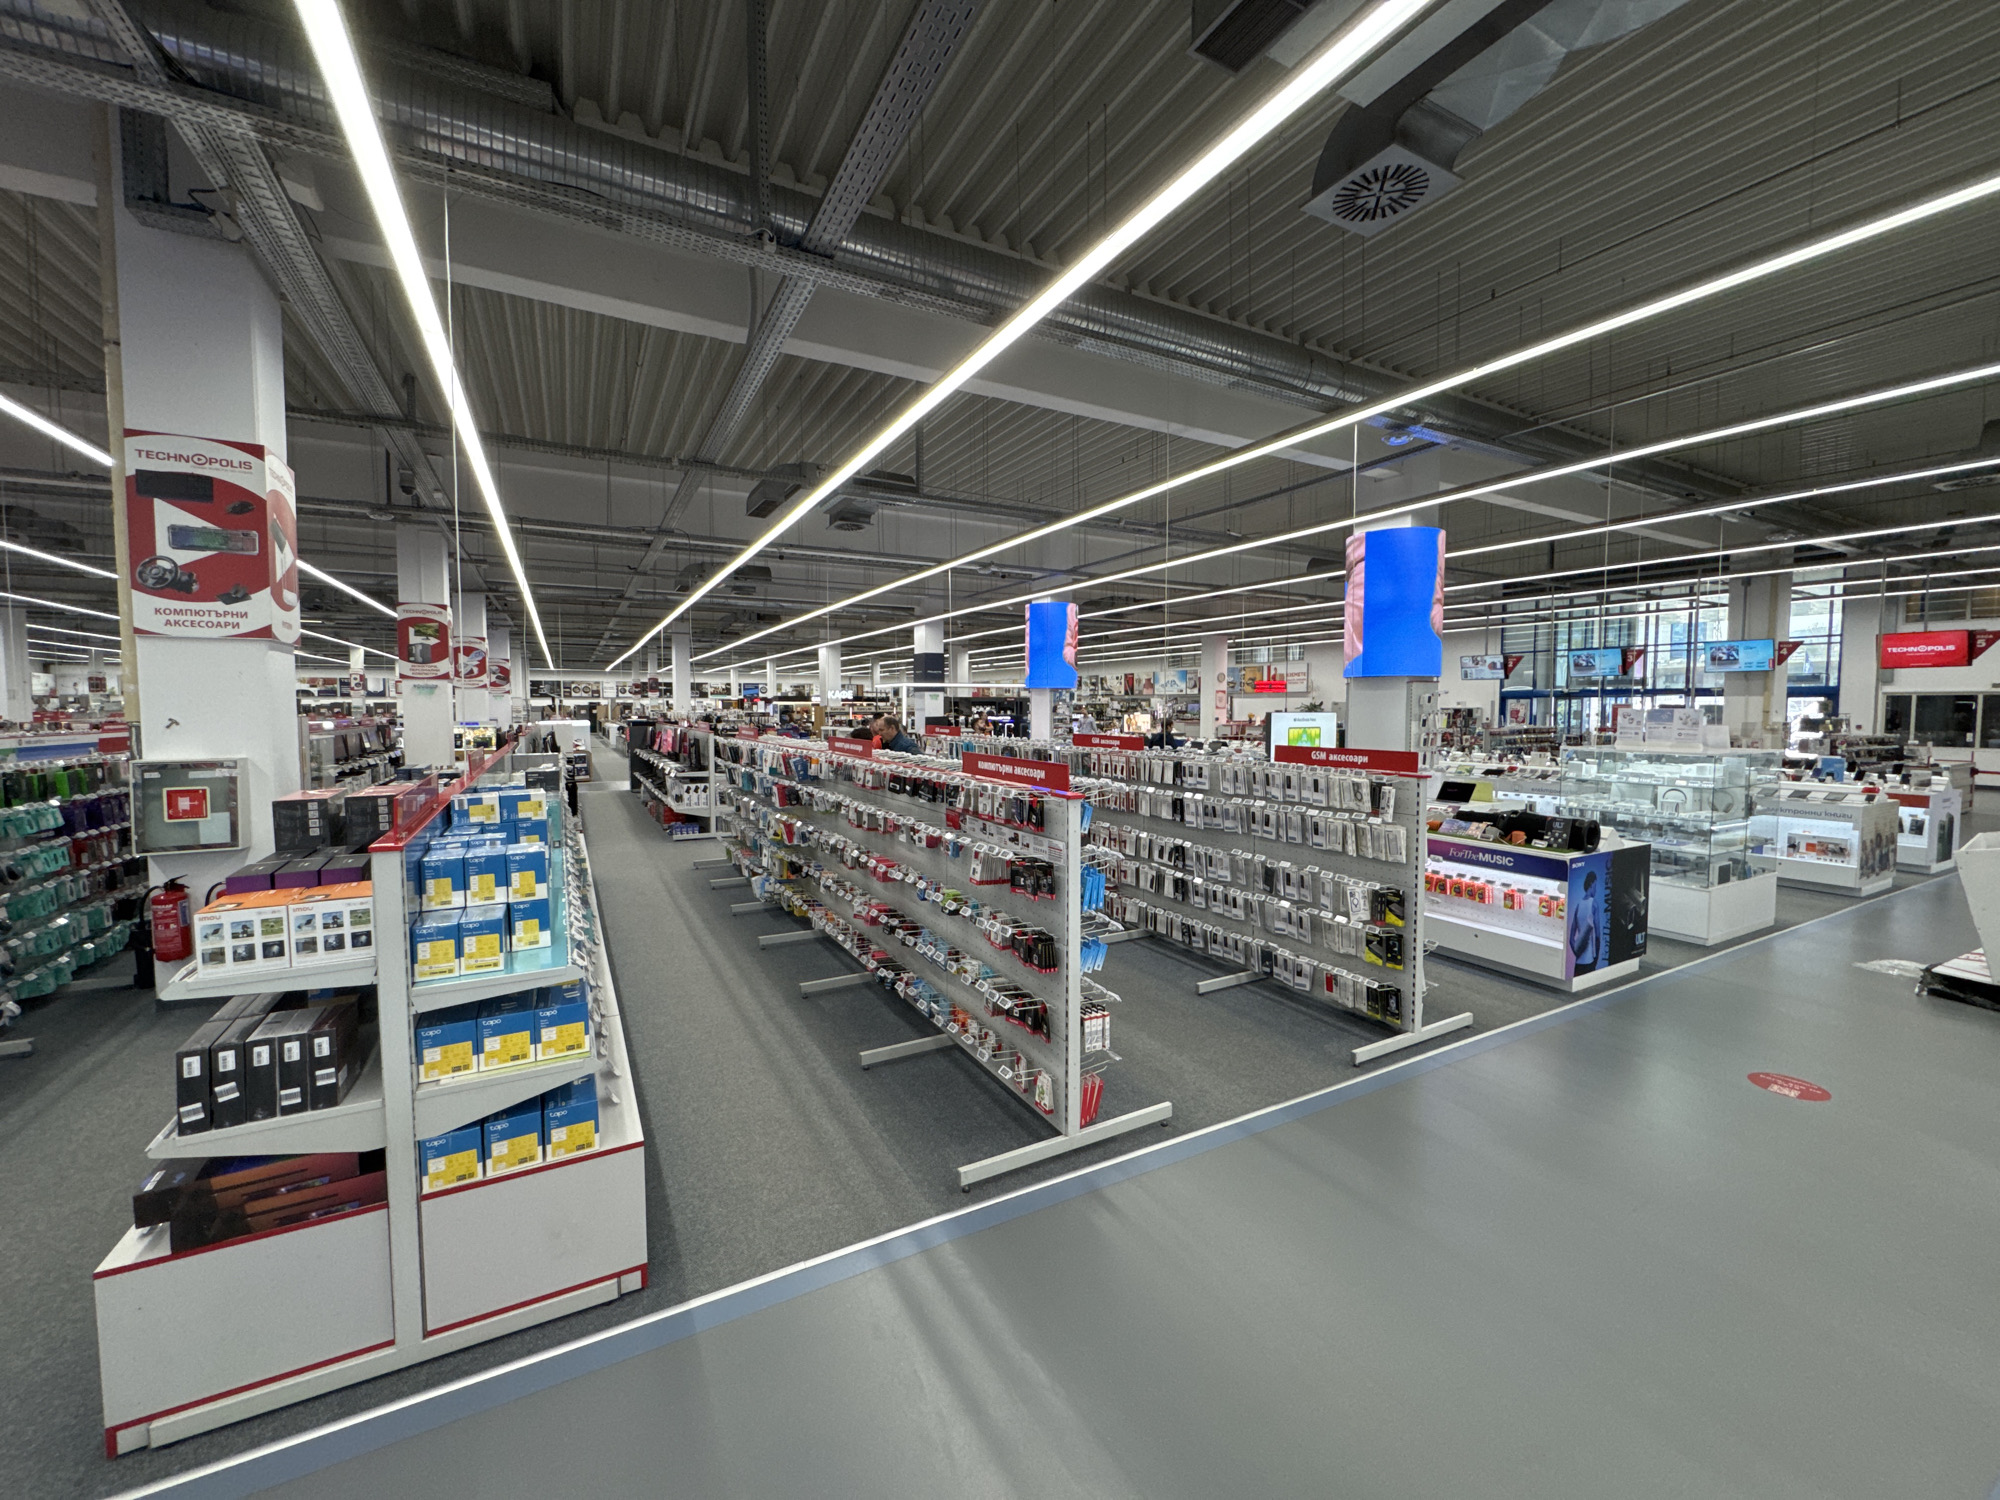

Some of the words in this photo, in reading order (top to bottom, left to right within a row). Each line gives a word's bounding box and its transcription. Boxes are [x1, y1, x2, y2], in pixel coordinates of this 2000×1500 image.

[135, 449, 254, 471] TECHNOPOLIS
[154, 607, 249, 620] КОМПЮТЪРНИ
[164, 619, 241, 630] АКСЕСОАРИ
[1976, 639, 1987, 648] 5
[1779, 647, 1788, 656] 4
[1886, 644, 1956, 653] TECHNOPOLIS
[1626, 654, 1633, 662] 3
[827, 689, 854, 699] КАФЕ
[1311, 750, 1327, 761] GSM
[1328, 753, 1369, 765] аксесоари
[978, 760, 1013, 775] компютърни
[1014, 766, 1046, 781] аксесоари
[1571, 861, 1586, 869] SONY
[415, 927, 434, 935] tapo
[539, 1010, 558, 1018] tapo
[482, 1018, 502, 1027] tapo
[421, 1029, 442, 1037] tapo
[549, 1109, 568, 1117] tapo
[489, 1122, 509, 1131] tapo
[426, 1138, 447, 1147] tapo
